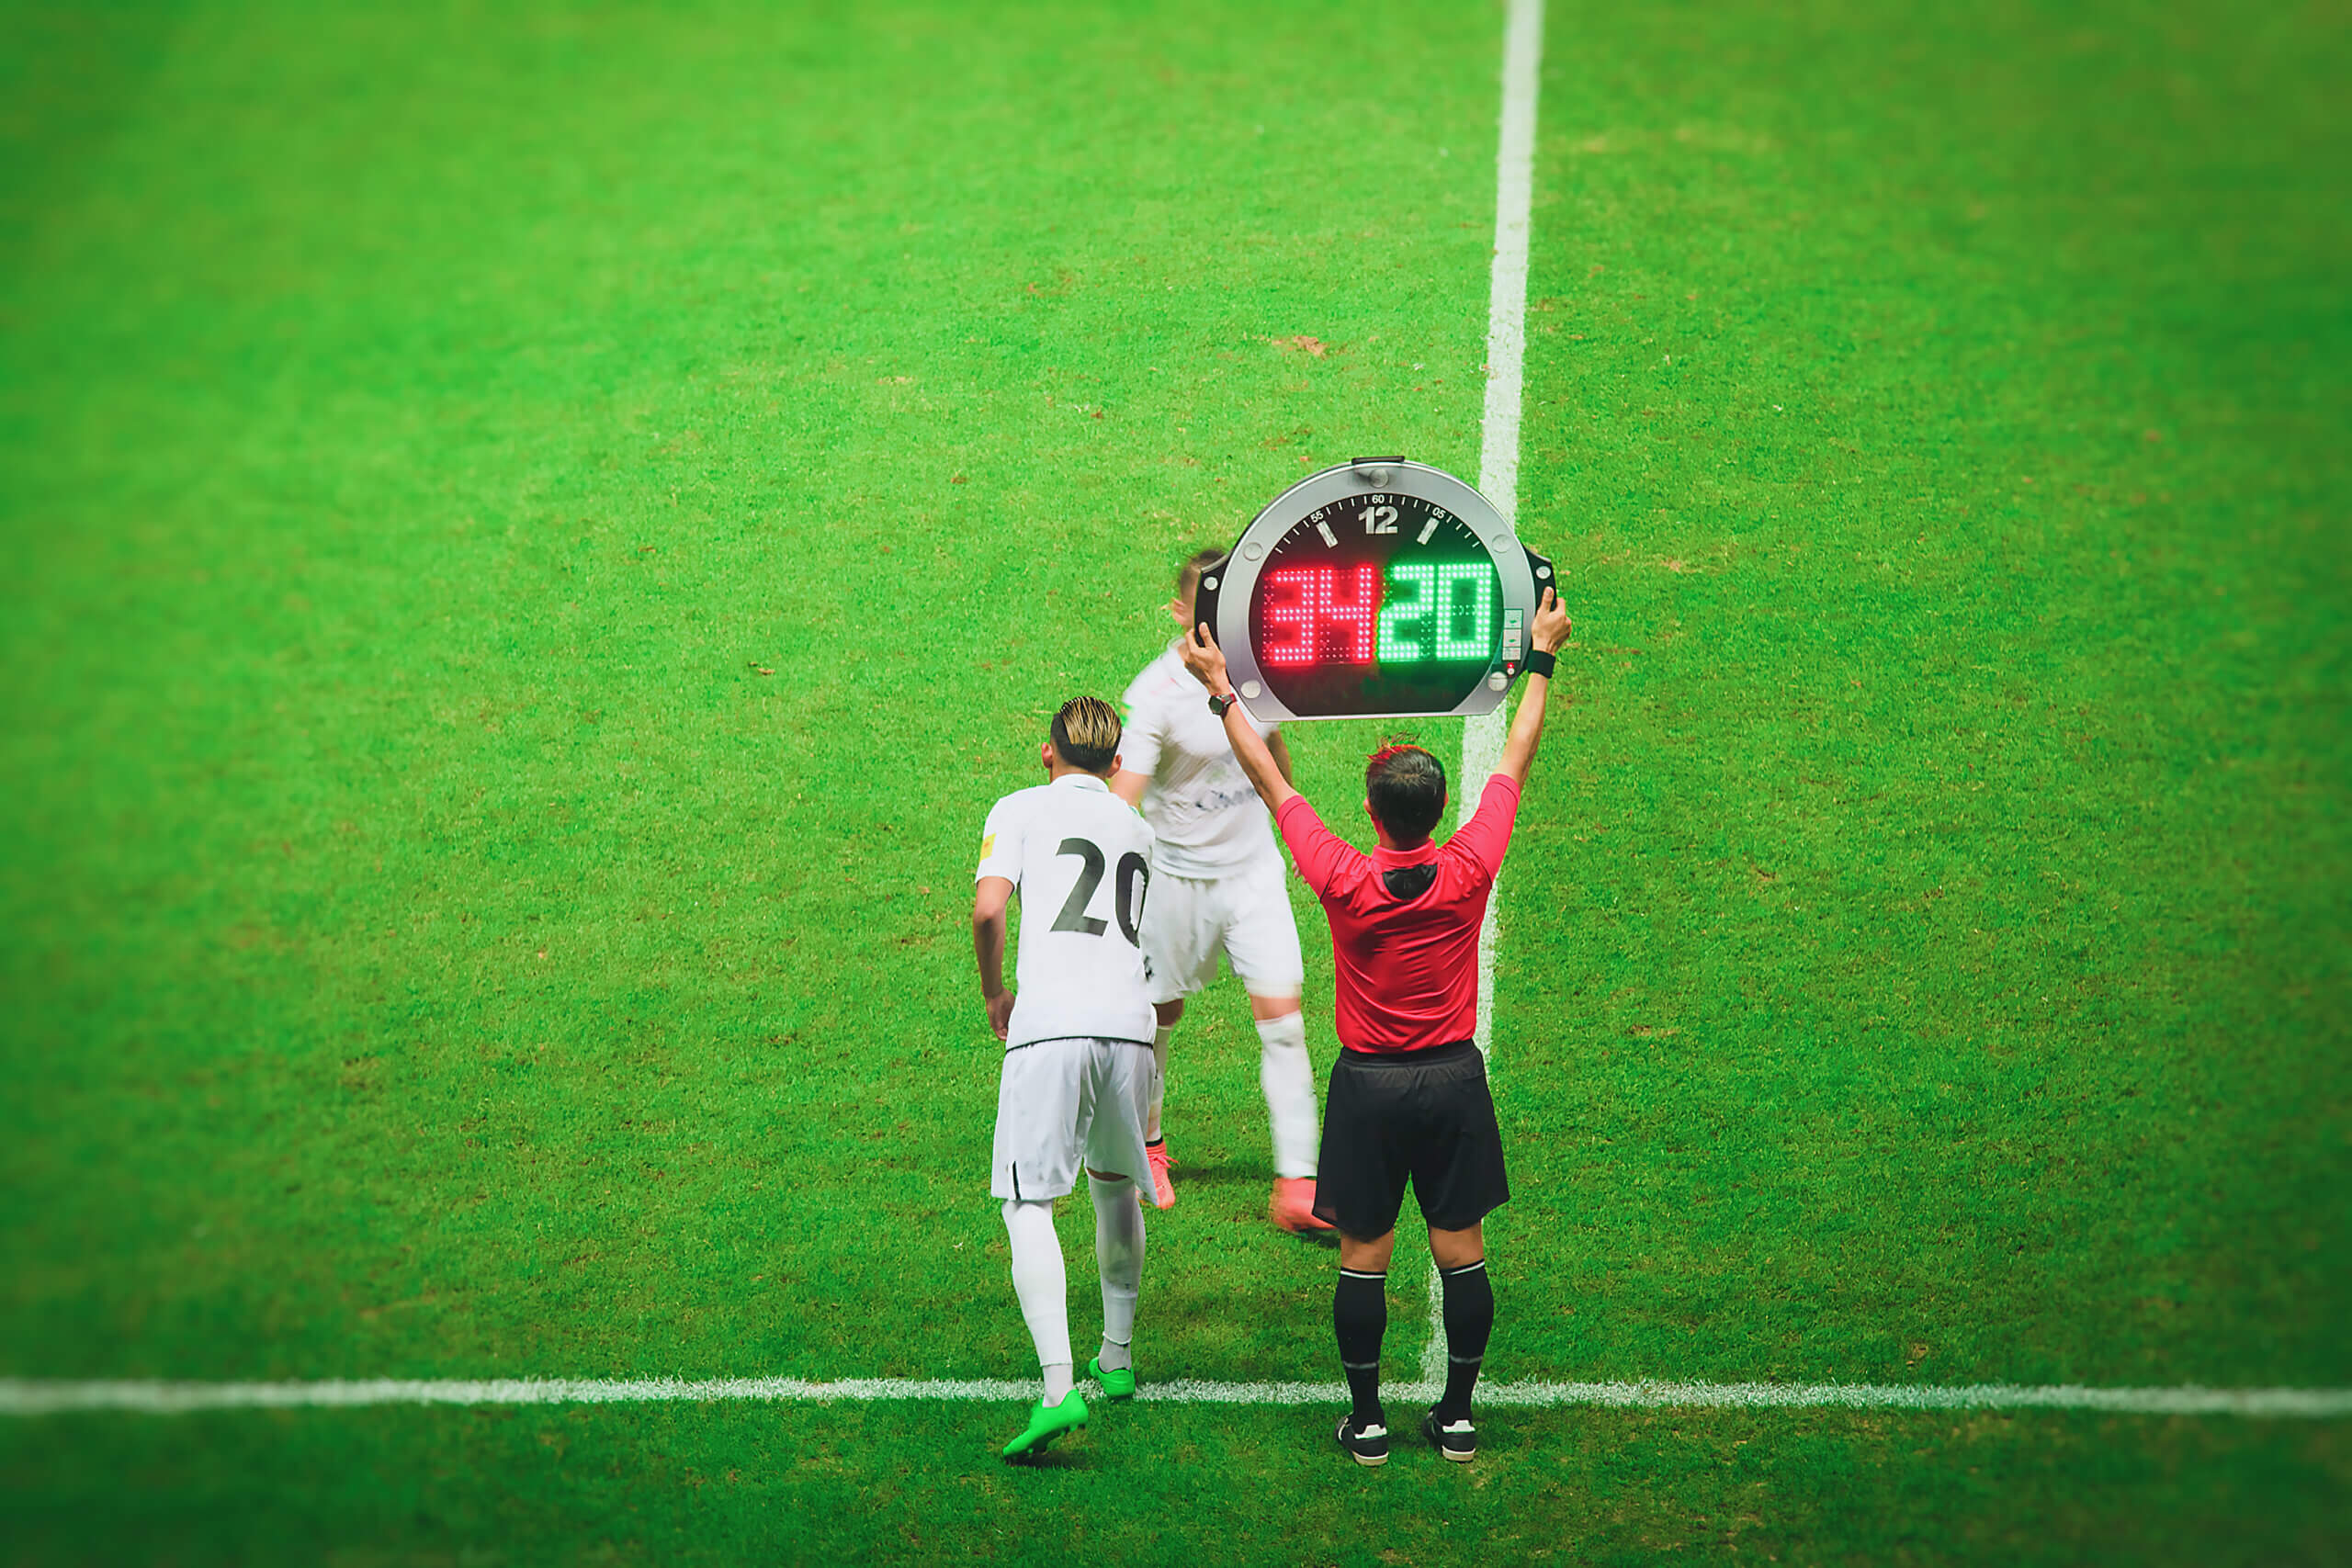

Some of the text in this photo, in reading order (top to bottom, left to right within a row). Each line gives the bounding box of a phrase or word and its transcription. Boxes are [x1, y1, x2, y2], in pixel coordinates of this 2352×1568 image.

[1372, 494, 1385, 504] 60
[1310, 510, 1324, 524] 55
[1358, 506, 1398, 535] 12
[1432, 506, 1446, 520] 05
[1271, 565, 1374, 663] 34
[1378, 562, 1492, 661] 20
[1050, 837, 1150, 950] 20
